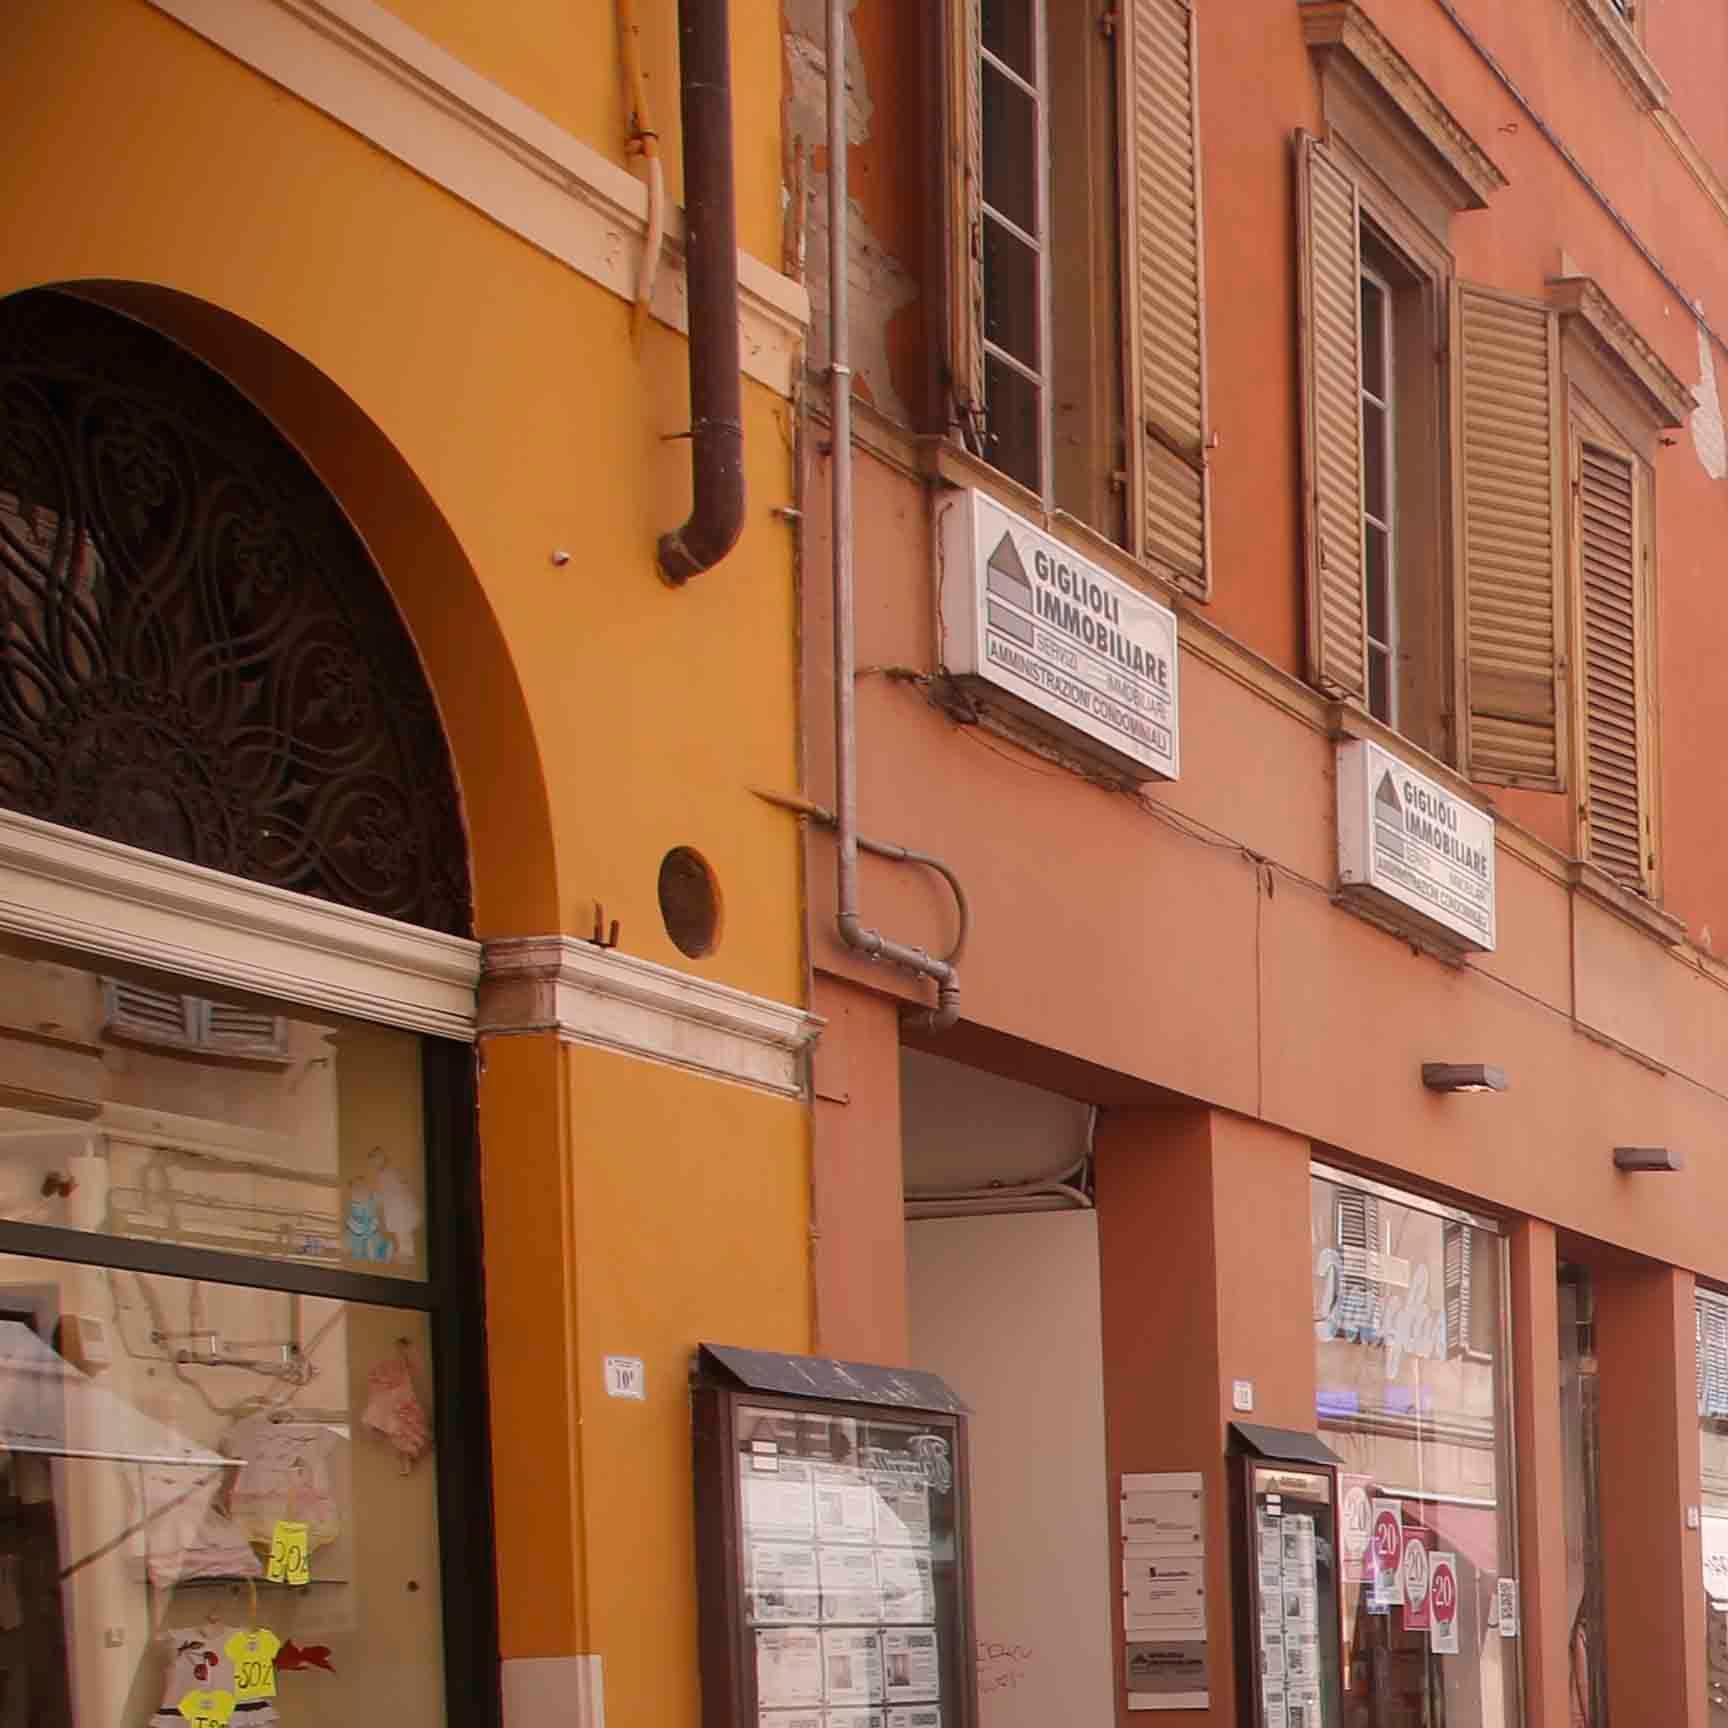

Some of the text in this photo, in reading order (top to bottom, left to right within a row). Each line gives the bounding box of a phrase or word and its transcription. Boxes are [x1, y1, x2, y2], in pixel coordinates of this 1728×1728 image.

[1035, 550, 1119, 625] GIGLIOLI
[1036, 587, 1168, 689] IMMOBILIARE
[988, 640, 1168, 750] AMMINISTRAZIONI CONDOMINIALI
[1403, 781, 1457, 833] GIGLIOLI
[1405, 808, 1488, 879] IMMOBILIARE
[1373, 1523, 1397, 1556] -20
[1431, 1575, 1452, 1607] -20
[234, 1661, 273, 1689] -50%
